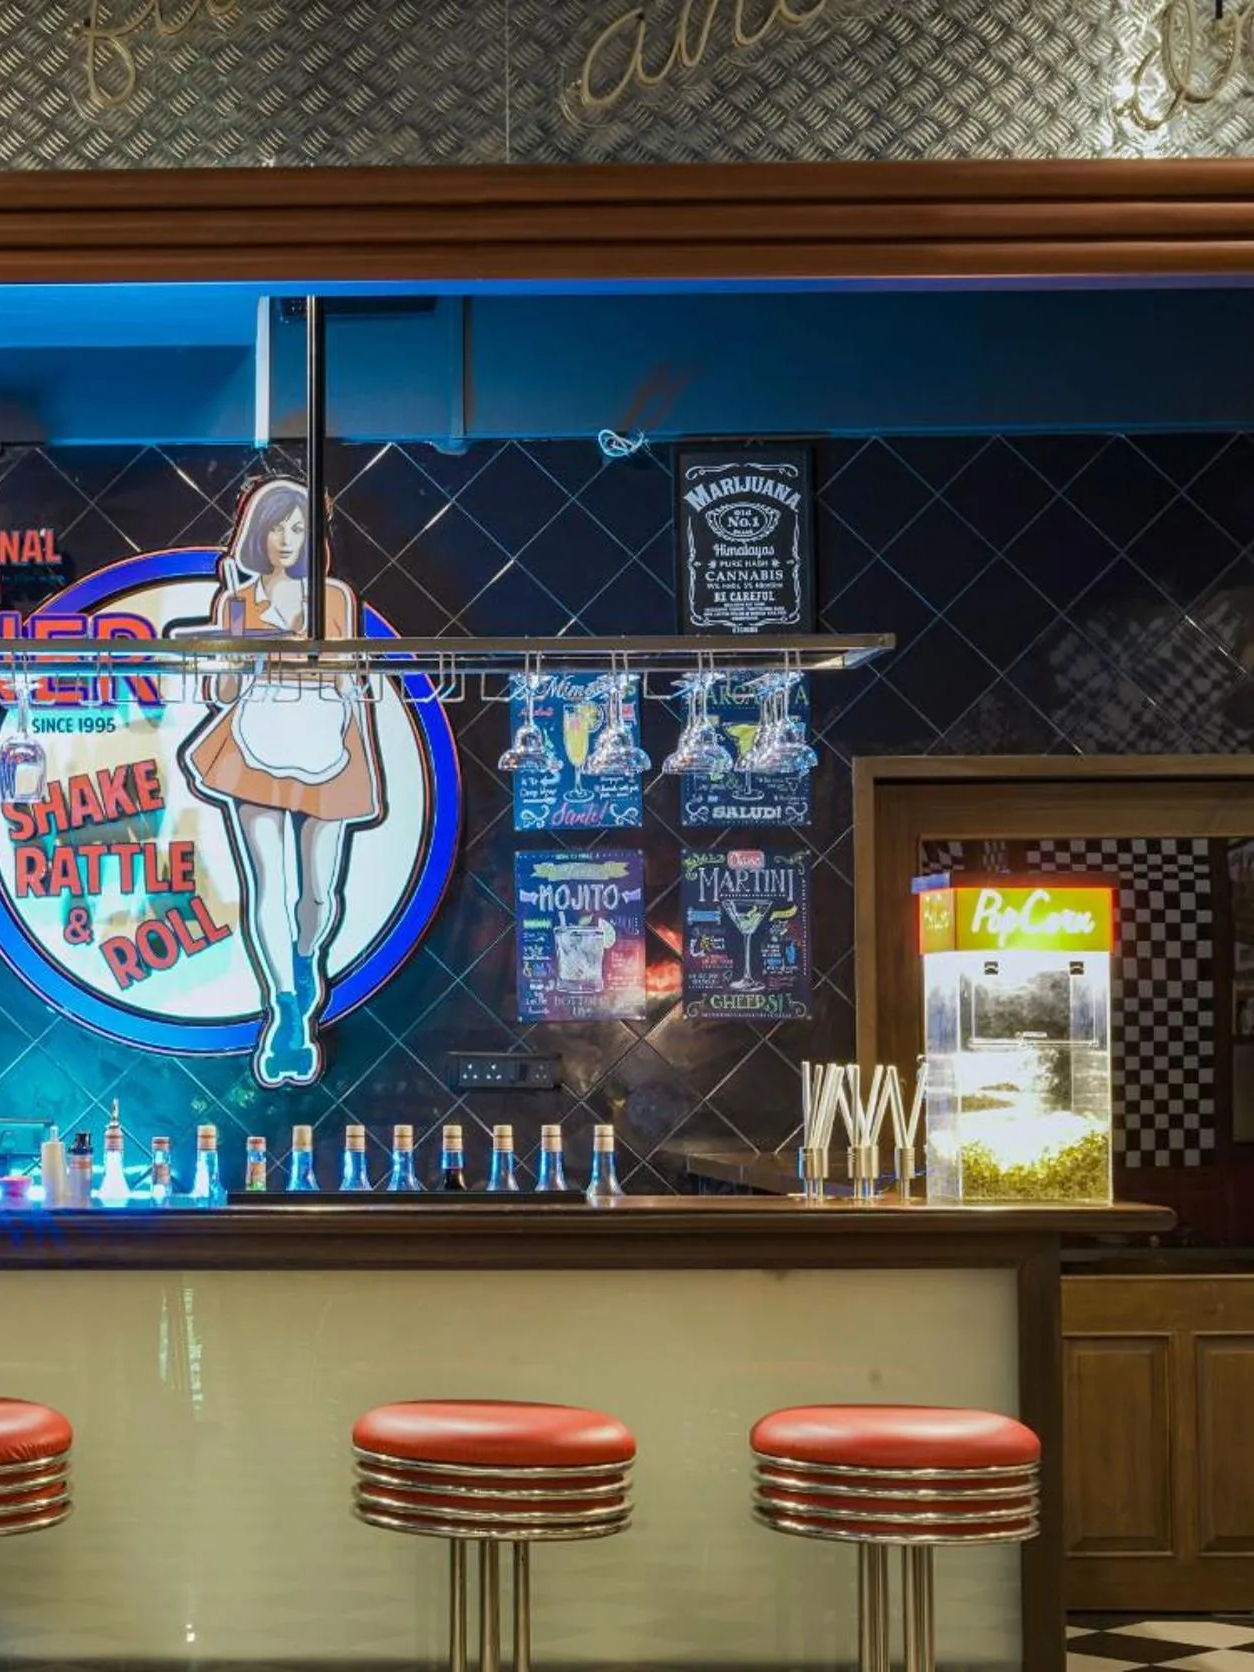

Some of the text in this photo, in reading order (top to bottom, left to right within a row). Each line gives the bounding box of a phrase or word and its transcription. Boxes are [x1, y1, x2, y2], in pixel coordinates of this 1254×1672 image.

[683, 475, 801, 513] MARIJUANA
[727, 517, 760, 528] No.1
[712, 543, 776, 559] Himalayas
[705, 569, 784, 581] CANNABIS
[730, 590, 776, 602] CAREFUL
[32, 717, 116, 733] SINCE 1995
[1, 758, 165, 842] SHAKE
[711, 806, 783, 820] SALUD!
[14, 841, 196, 898] RATTLE
[538, 883, 620, 912] MOJITO
[698, 867, 794, 902] MARTINI
[63, 906, 93, 945] &
[99, 895, 232, 990] ROLL
